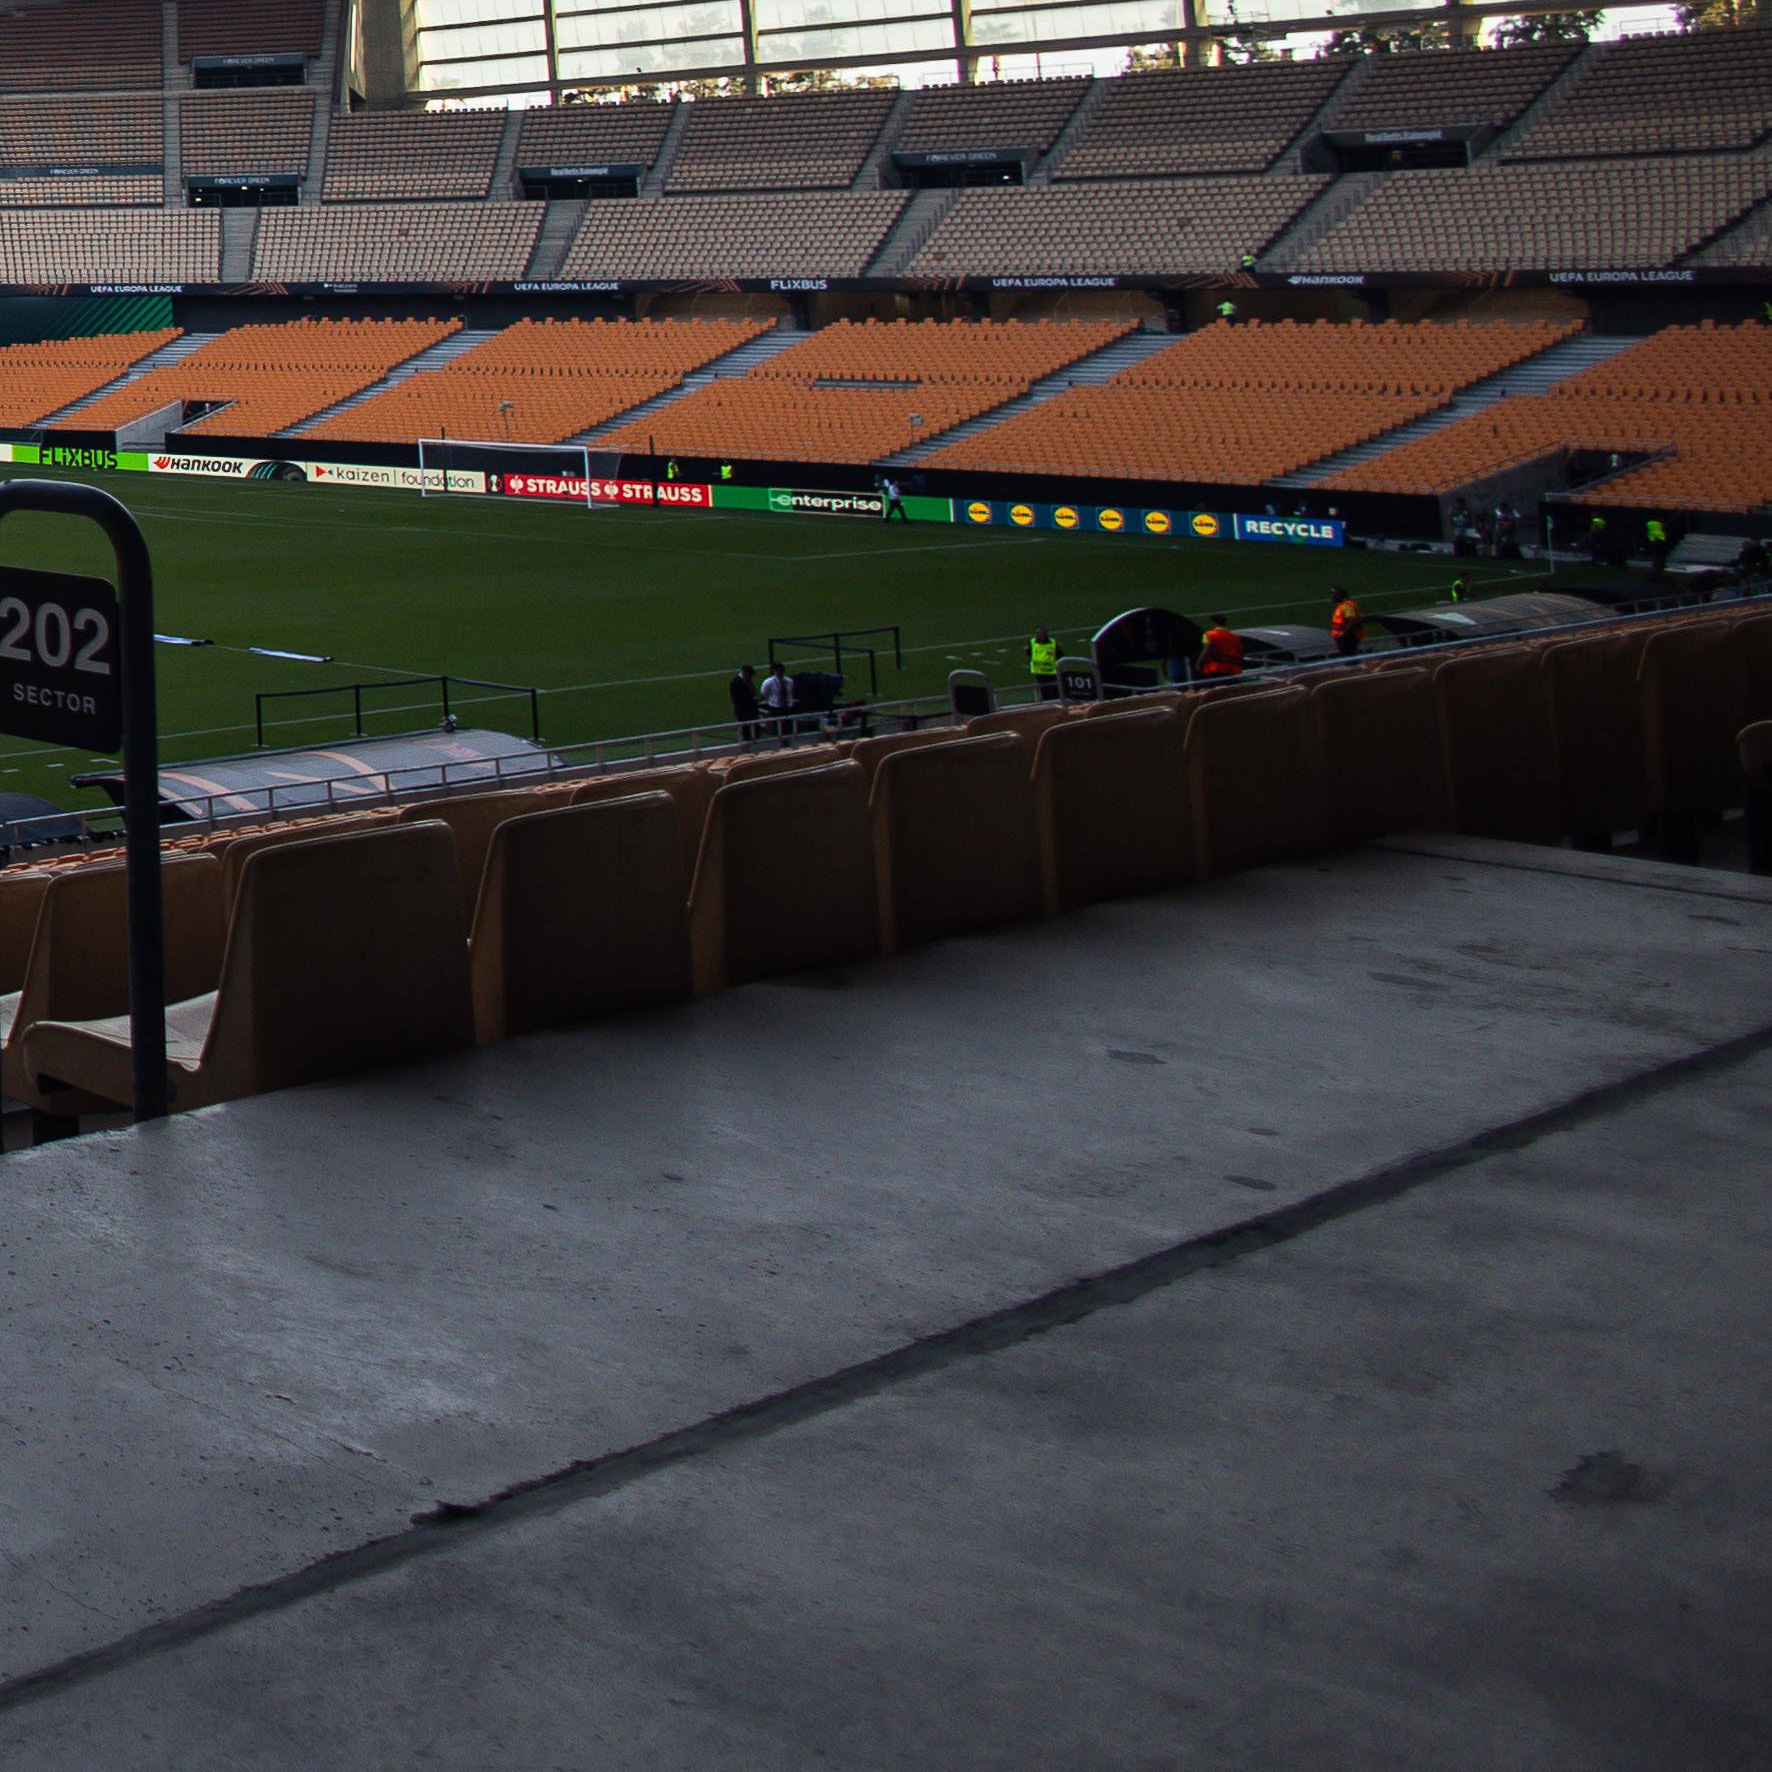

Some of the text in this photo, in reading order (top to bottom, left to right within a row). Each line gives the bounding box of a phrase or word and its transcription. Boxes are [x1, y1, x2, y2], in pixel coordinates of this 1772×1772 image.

[992, 278, 1116, 286] UEFA EUROPA LEAGUE
[1549, 270, 1693, 282] UEFA EUROPA LEAGUE
[336, 465, 390, 482] kaizen
[526, 477, 703, 502] STRAUSS STRAUSS
[776, 493, 883, 511] enterprise
[1245, 519, 1335, 539] RECYCLE
[1067, 675, 1092, 688] 101
[12, 682, 96, 715] SECTOR
